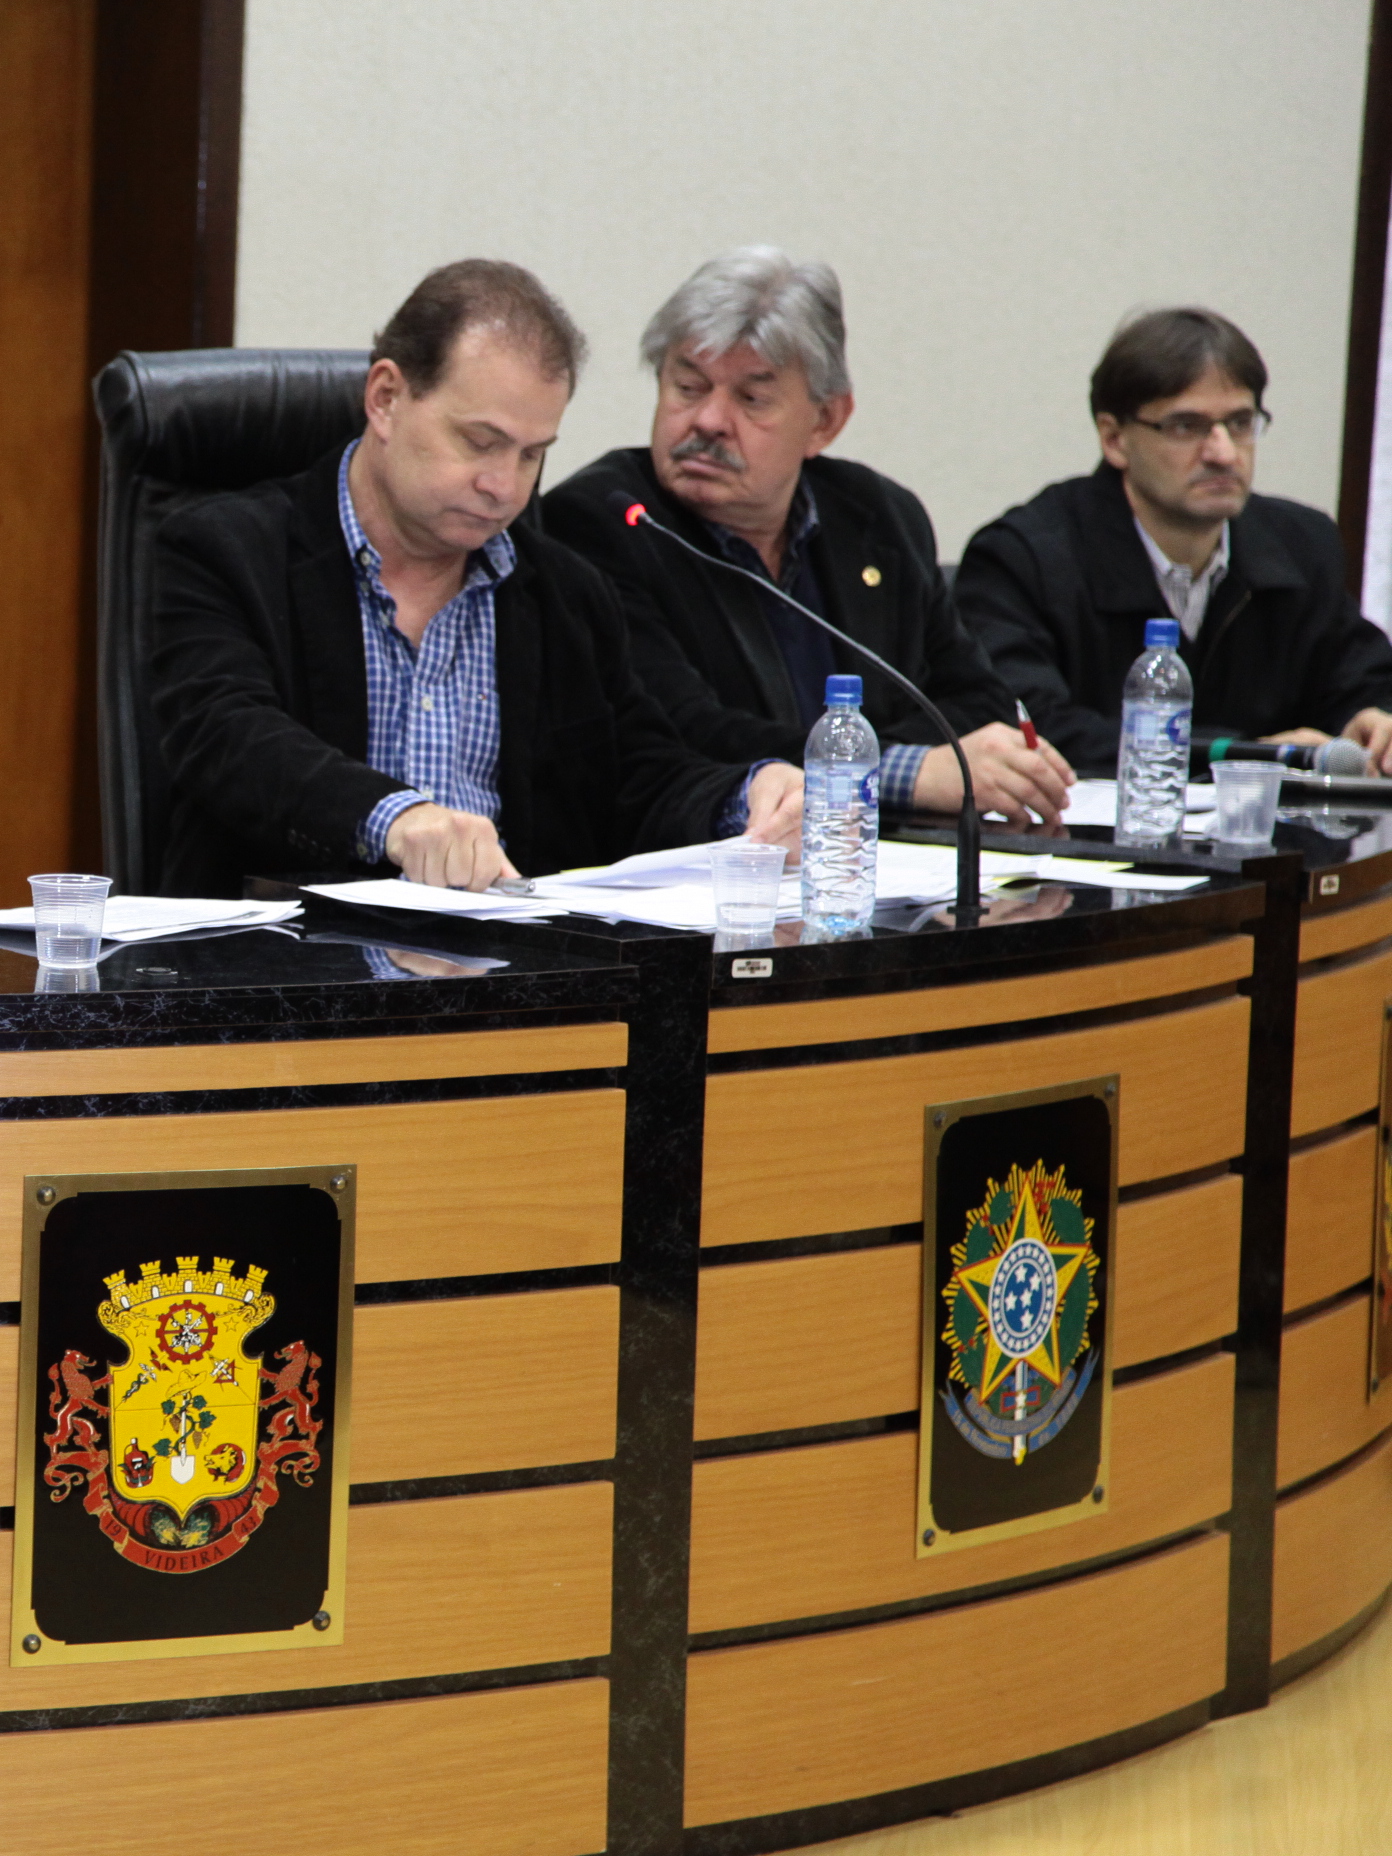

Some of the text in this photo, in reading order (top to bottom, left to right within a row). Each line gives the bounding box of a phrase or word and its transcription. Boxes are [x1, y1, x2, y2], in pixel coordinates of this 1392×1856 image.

[104, 1516, 257, 1536] 19 43
[144, 1546, 225, 1571] VIDEIRA
